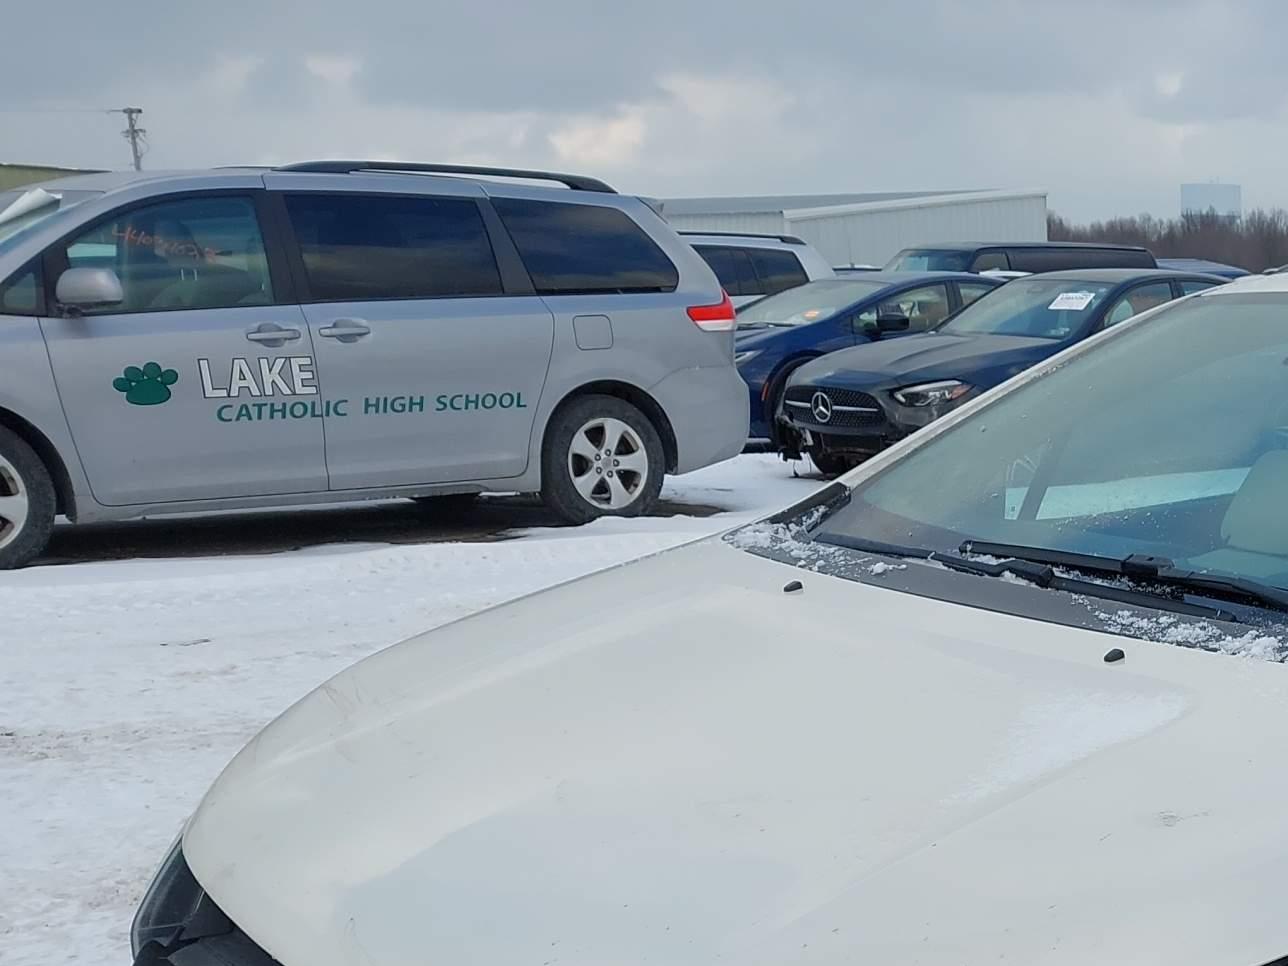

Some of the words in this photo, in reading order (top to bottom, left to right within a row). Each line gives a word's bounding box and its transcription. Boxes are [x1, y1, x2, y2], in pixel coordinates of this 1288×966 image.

[197, 355, 319, 399] LAKE
[216, 399, 349, 423] CATHOLIC
[363, 395, 425, 415] HIGH
[435, 391, 528, 412] SCHOOL
